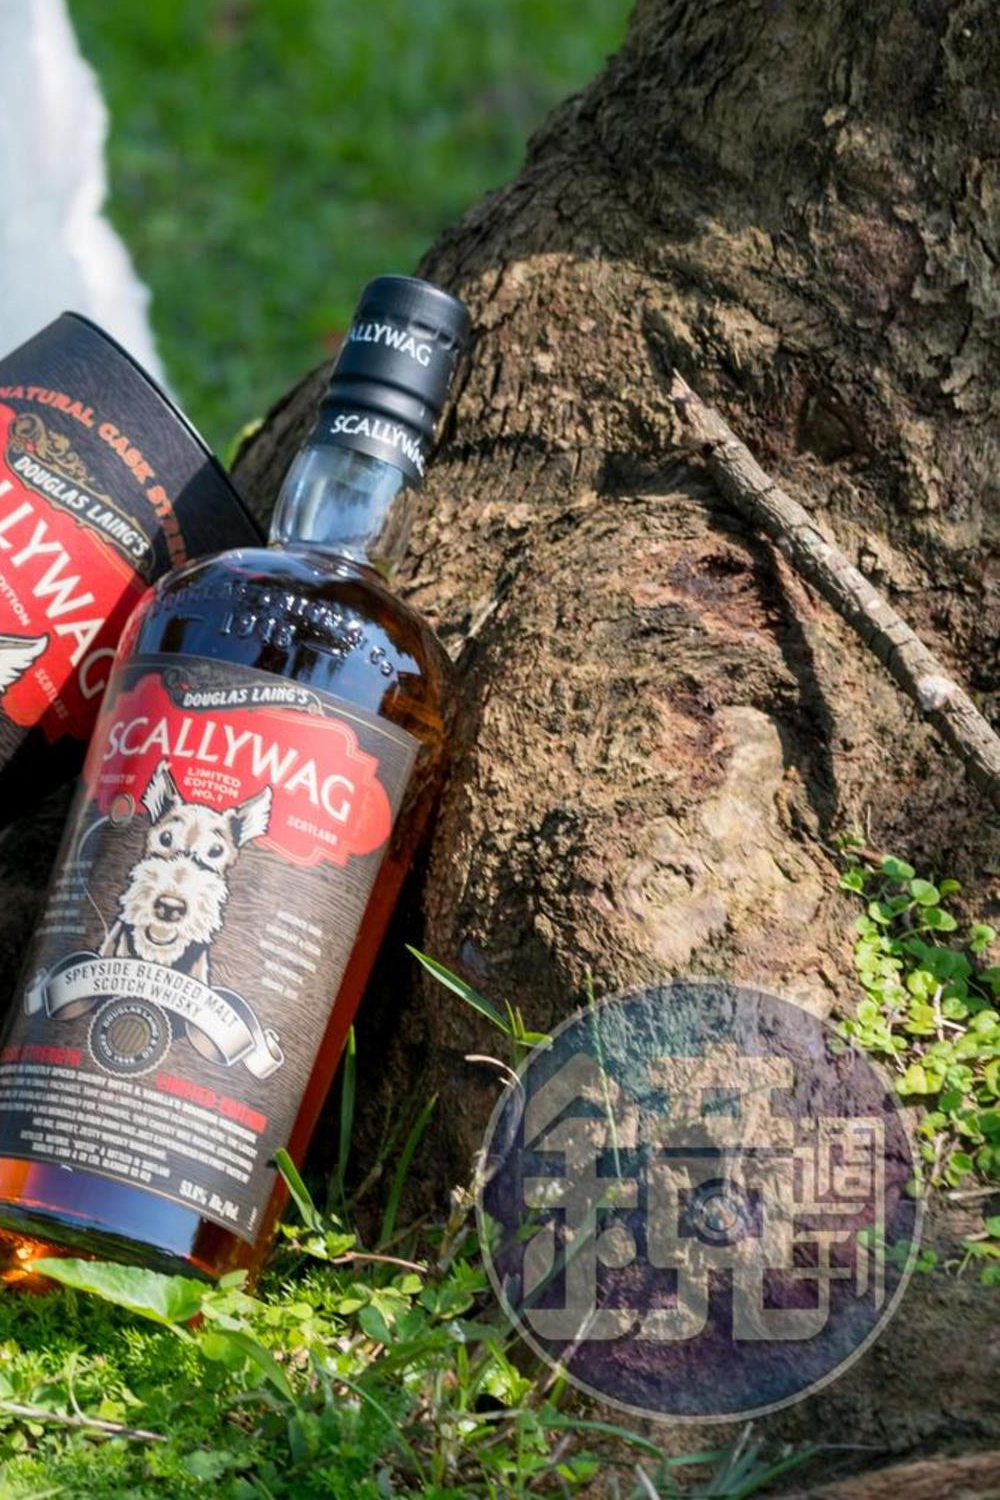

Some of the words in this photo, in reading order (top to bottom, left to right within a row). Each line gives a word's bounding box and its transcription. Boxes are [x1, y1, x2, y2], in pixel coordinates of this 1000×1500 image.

[99, 422, 155, 484] CASK
[14, 455, 90, 511] DOUGLAS
[86, 497, 150, 558] LAING'S
[183, 688, 249, 708] DOUGLAS
[251, 686, 311, 706] LAING'S
[103, 716, 356, 823] SCALLYWAG
[187, 766, 242, 788] LIMITED
[183, 777, 240, 799] EDITION
[190, 788, 225, 805] NO.1
[286, 814, 339, 846] SCOTLAND
[64, 961, 131, 985] SPEYSIDE
[135, 966, 203, 1001] BLENDED
[204, 994, 239, 1028] MALT
[92, 977, 147, 994] SCOTCH
[149, 981, 203, 1018] WHISKY
